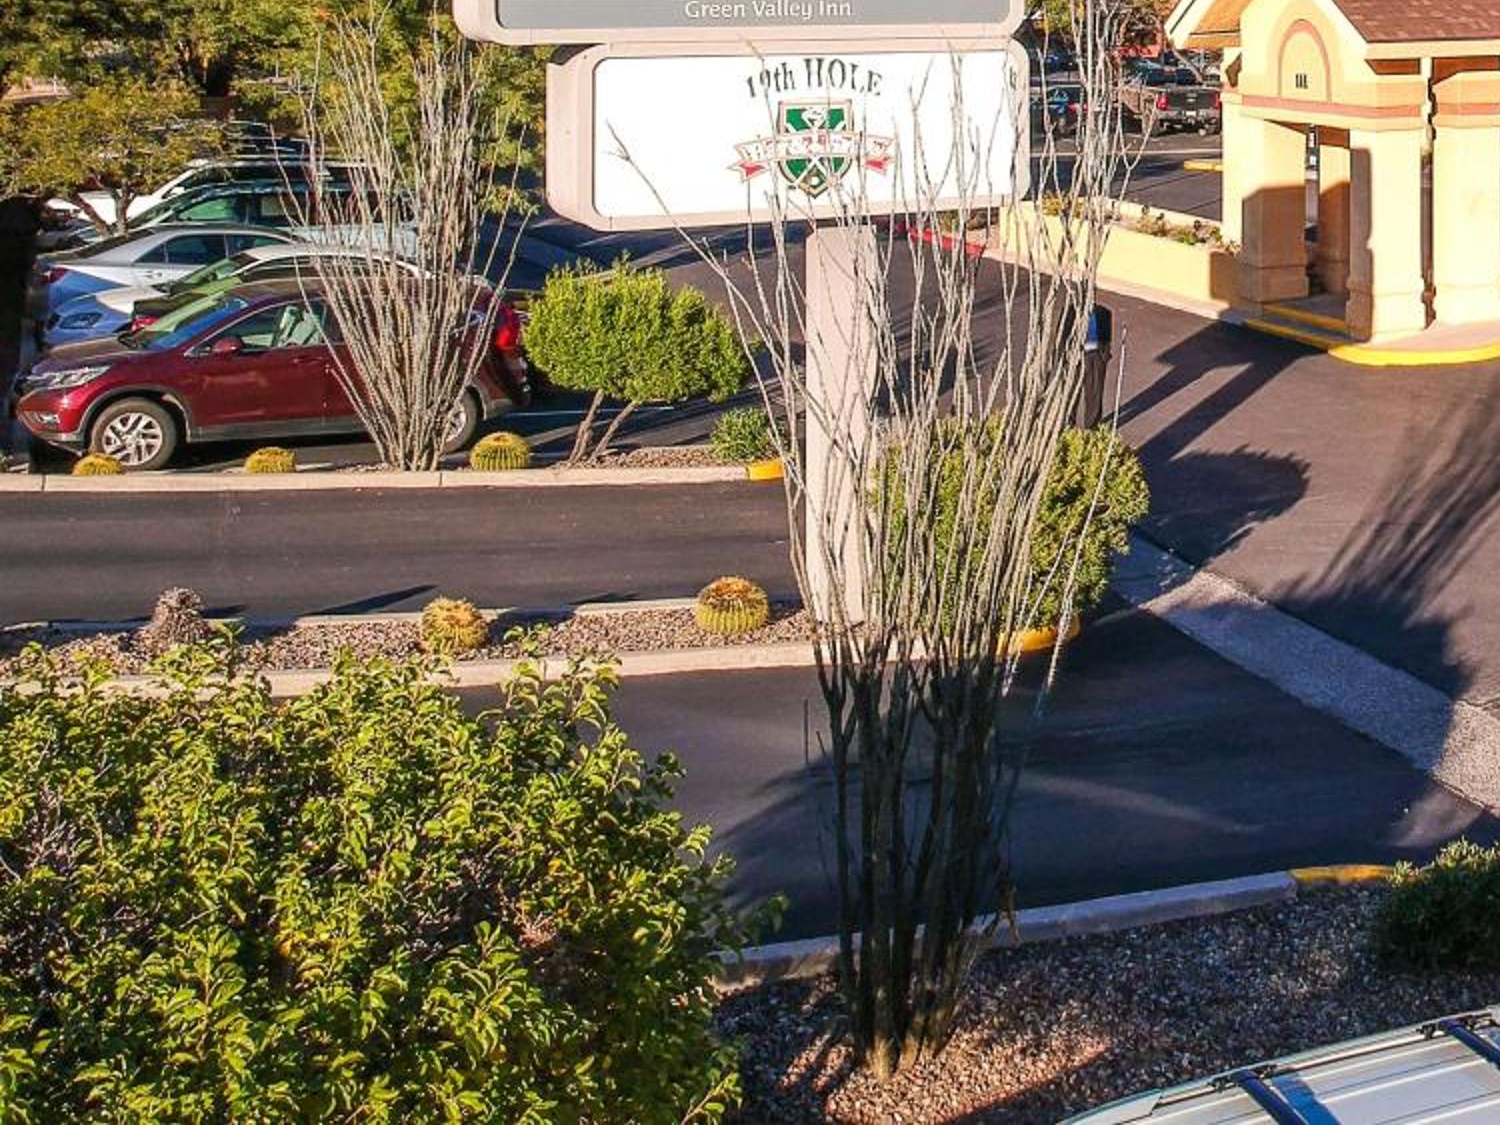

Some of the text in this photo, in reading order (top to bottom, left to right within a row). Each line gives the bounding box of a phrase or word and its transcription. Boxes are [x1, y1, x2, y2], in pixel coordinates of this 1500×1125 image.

[685, 0, 852, 20] Green Valley Inn
[747, 57, 883, 98] 19th HOLE
